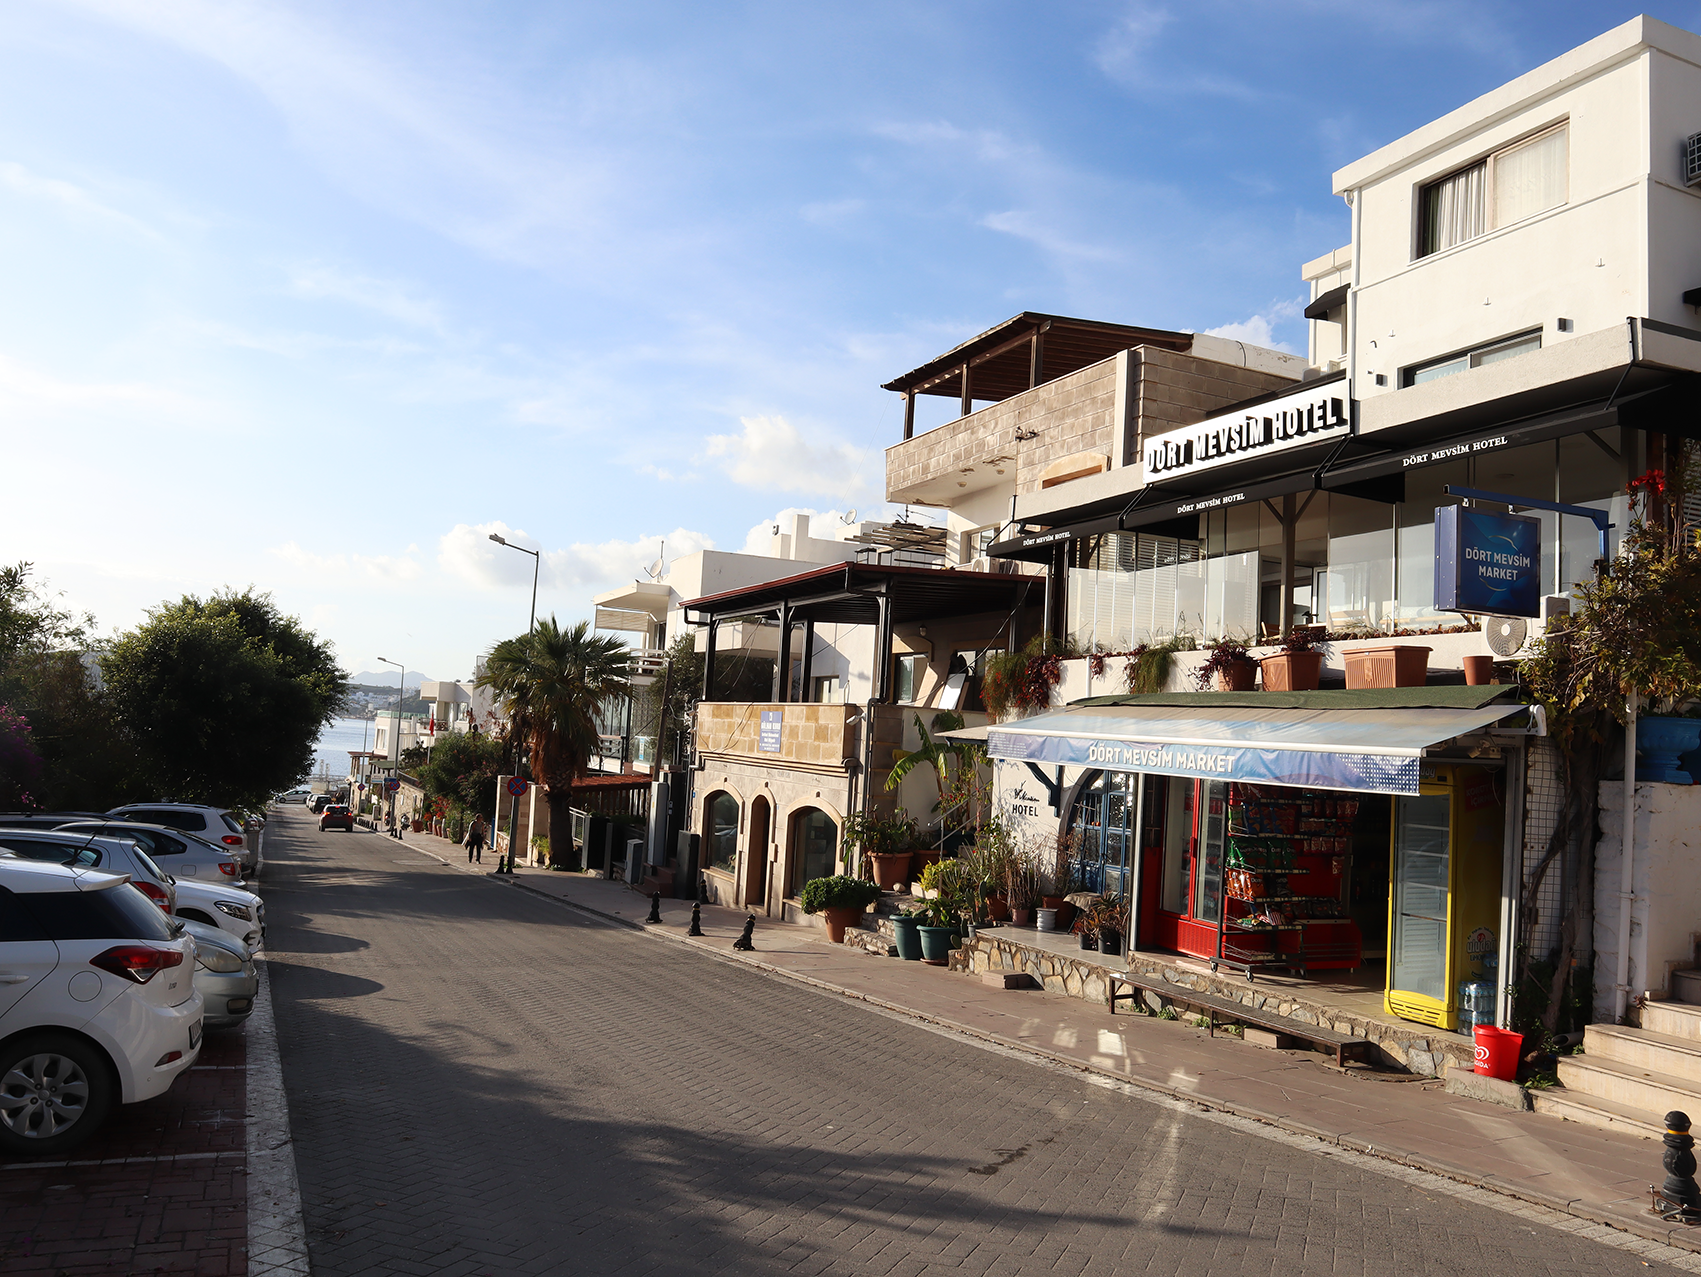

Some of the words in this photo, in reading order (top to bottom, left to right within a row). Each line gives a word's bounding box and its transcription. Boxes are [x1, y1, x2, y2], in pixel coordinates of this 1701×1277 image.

[1147, 440, 1191, 473] DÖRT
[1195, 416, 1268, 460] MEVSİM
[1272, 397, 1342, 440] HOTEL
[1402, 453, 1429, 467] DÖRT
[1431, 444, 1470, 461] MEVSİM
[1472, 436, 1508, 451] HOTEL
[1177, 504, 1195, 514] DÖRT
[1196, 498, 1221, 510] MEVSİM
[1222, 493, 1246, 504] HOTEL
[1055, 531, 1071, 540] HOTEL
[1465, 546, 1492, 562] DÖRT
[1493, 552, 1530, 568] MEVSİM
[1478, 565, 1518, 581] MARKET
[1089, 743, 1121, 763] DÖRT
[1123, 747, 1173, 768] MEVSİM
[1176, 752, 1236, 773] MARKET
[1012, 804, 1038, 817] HOTEL
